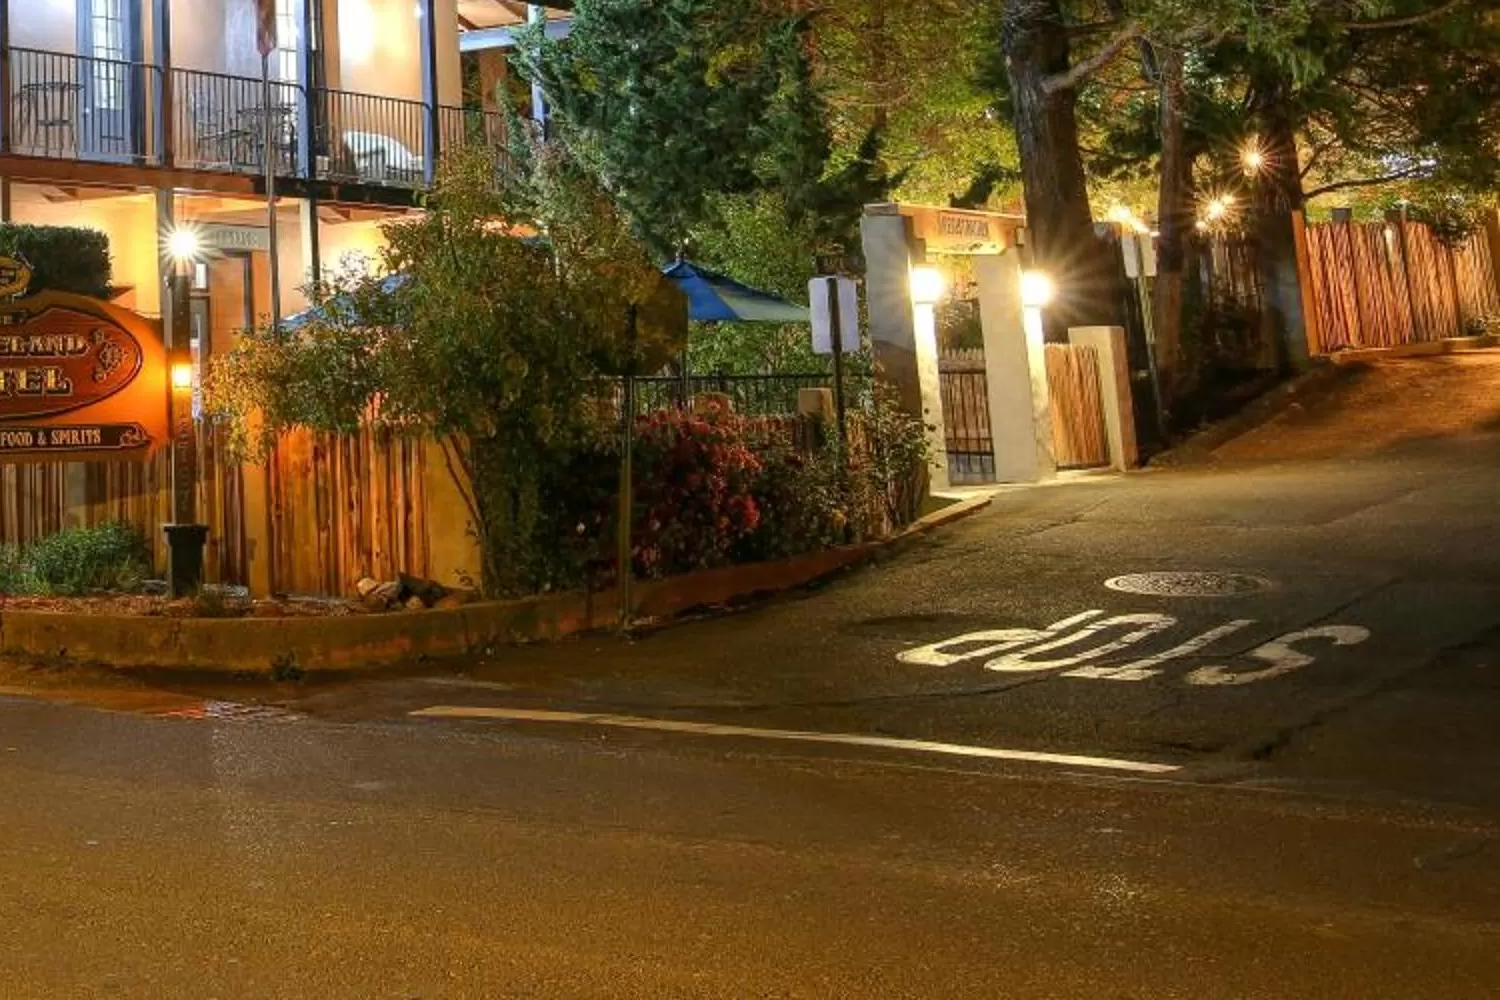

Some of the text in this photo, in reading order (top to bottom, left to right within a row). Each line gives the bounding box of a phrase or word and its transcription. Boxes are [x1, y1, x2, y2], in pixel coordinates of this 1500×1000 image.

[0, 430, 33, 447] FOOD
[38, 430, 47, 446] &
[51, 427, 101, 446] SPIRITS
[895, 608, 1371, 686] STOP
